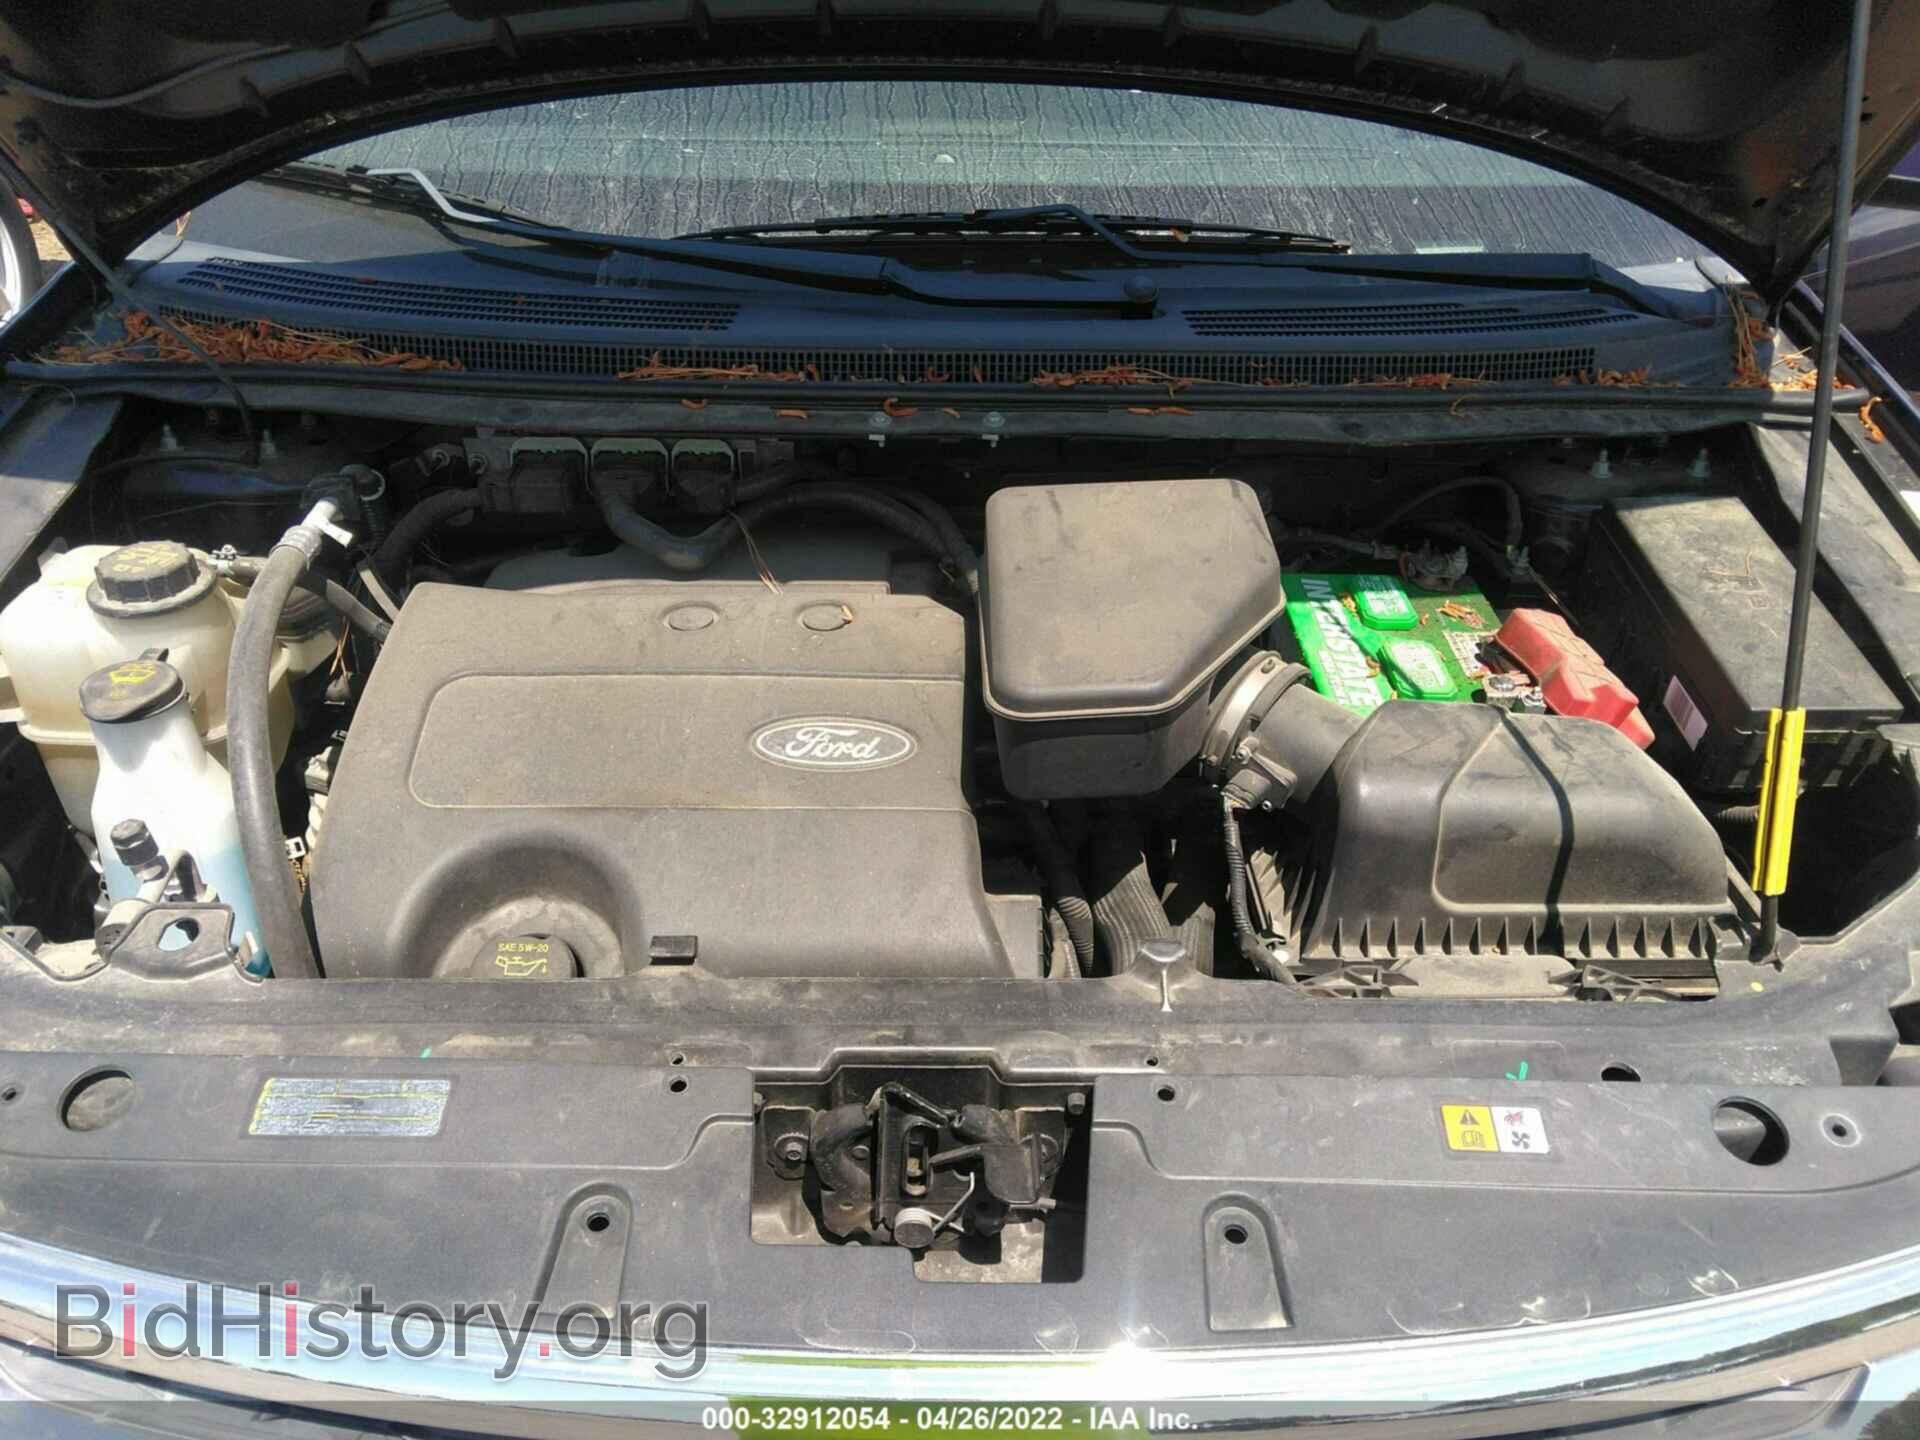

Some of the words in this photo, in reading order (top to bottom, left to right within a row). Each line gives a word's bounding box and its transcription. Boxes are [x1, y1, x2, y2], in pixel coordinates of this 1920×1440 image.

[785, 727, 881, 759] Ford
[498, 943, 517, 952] SAE
[519, 943, 549, 952] 5W-20
